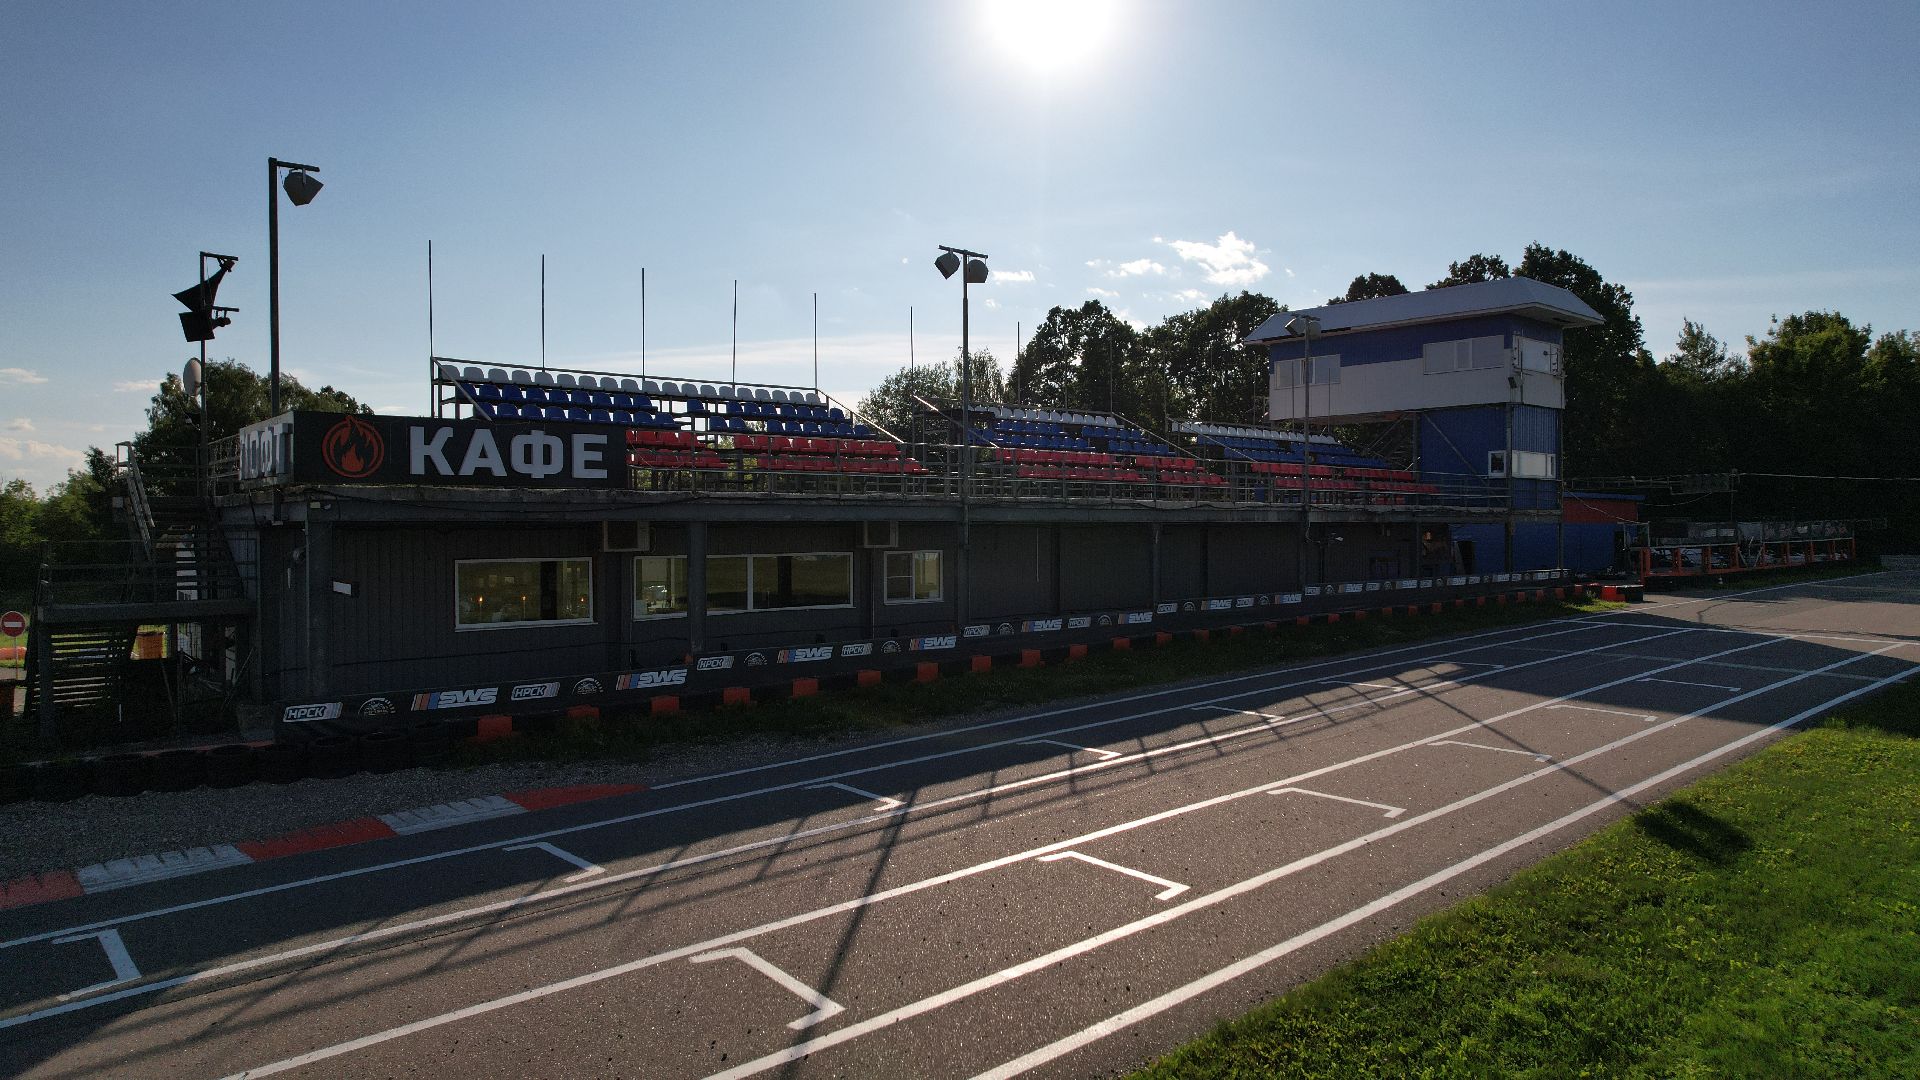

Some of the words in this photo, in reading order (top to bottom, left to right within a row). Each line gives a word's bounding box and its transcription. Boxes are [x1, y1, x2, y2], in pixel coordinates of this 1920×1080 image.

[410, 425, 608, 479] КАФЕ
[923, 635, 957, 650] SWS
[794, 646, 834, 662] SWS
[637, 669, 688, 689] SWS
[437, 687, 499, 709] SWS
